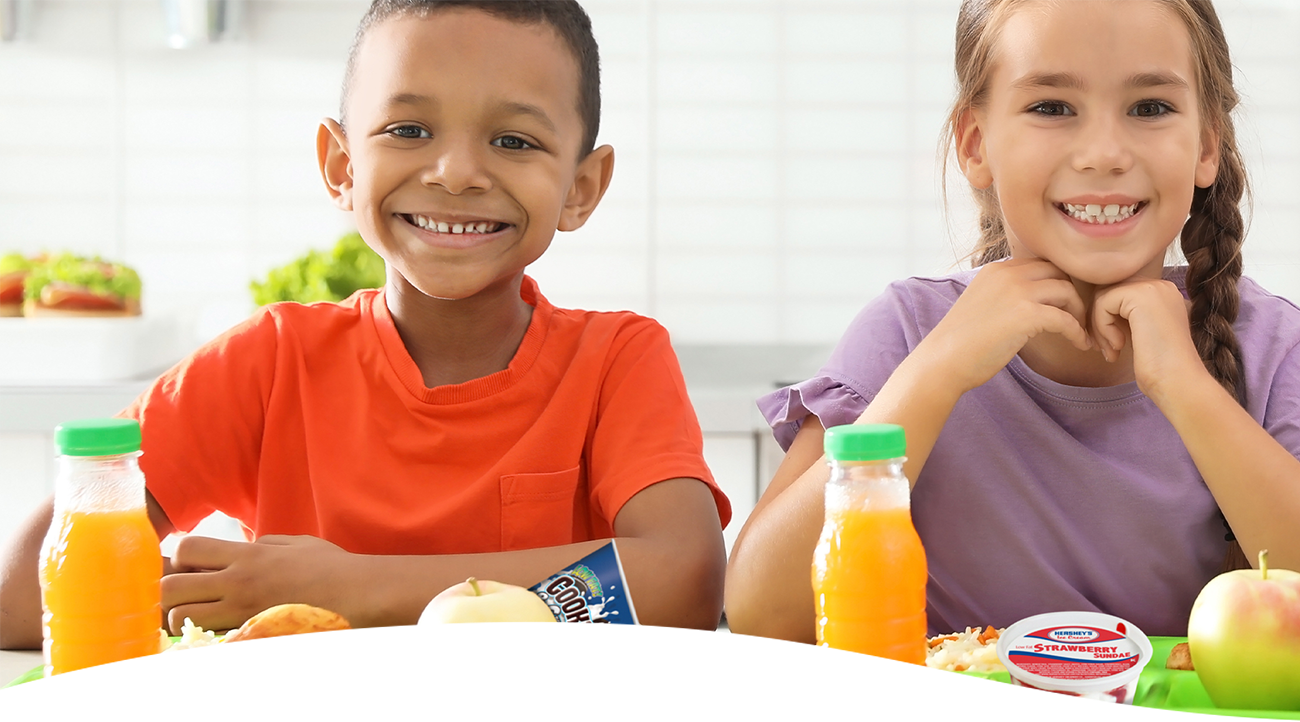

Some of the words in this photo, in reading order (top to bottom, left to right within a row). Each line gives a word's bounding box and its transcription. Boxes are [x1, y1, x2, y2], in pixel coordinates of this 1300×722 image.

[571, 564, 594, 580] LOW
[585, 576, 603, 598] FAT!
[1034, 643, 1118, 653] STRAWBERRY
